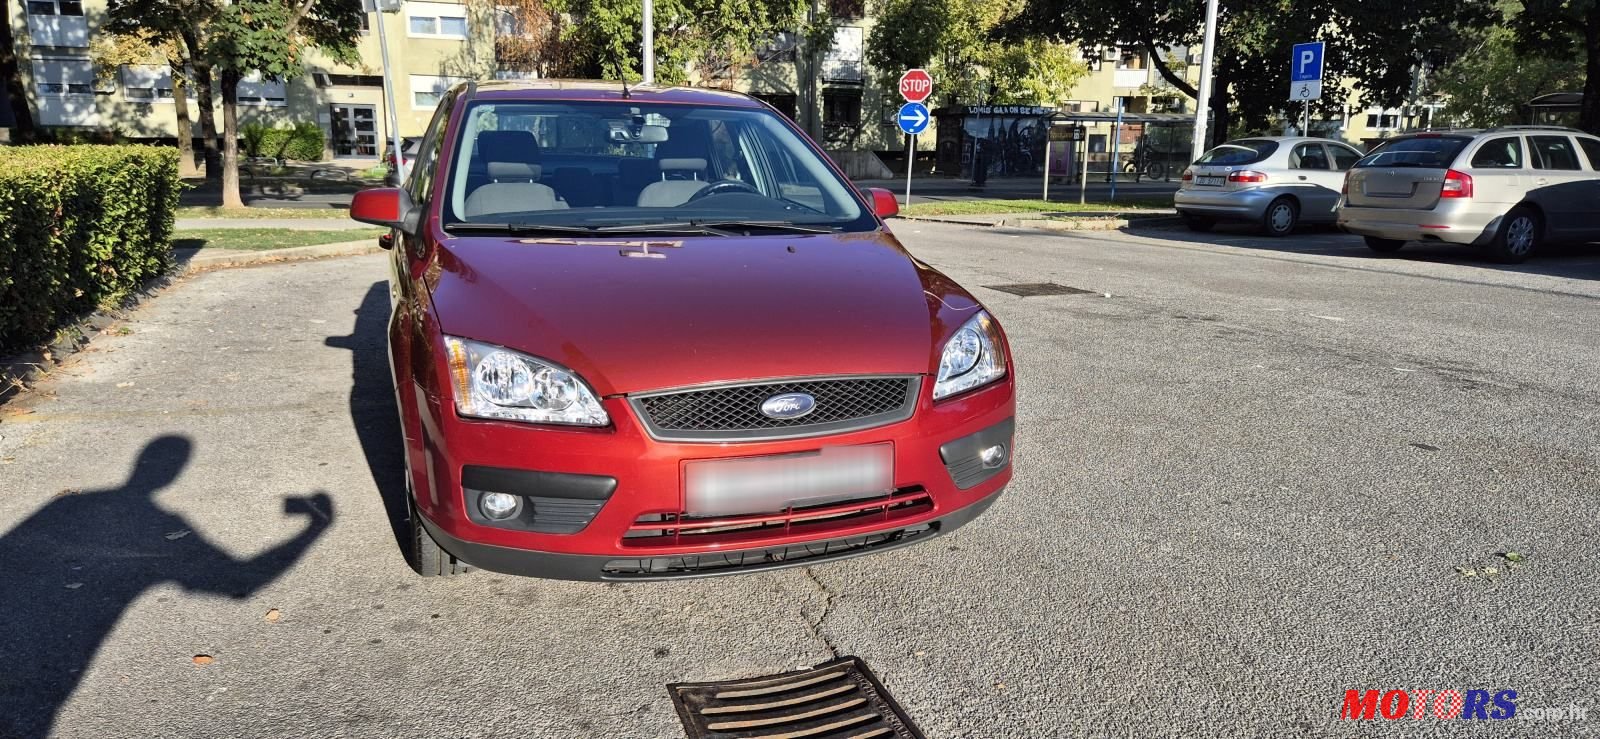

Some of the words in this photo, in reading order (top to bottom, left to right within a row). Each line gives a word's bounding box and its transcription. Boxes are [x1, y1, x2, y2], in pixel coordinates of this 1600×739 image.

[1300, 50, 1314, 73] P
[902, 79, 930, 92] STOP
[775, 397, 804, 413] Ford
